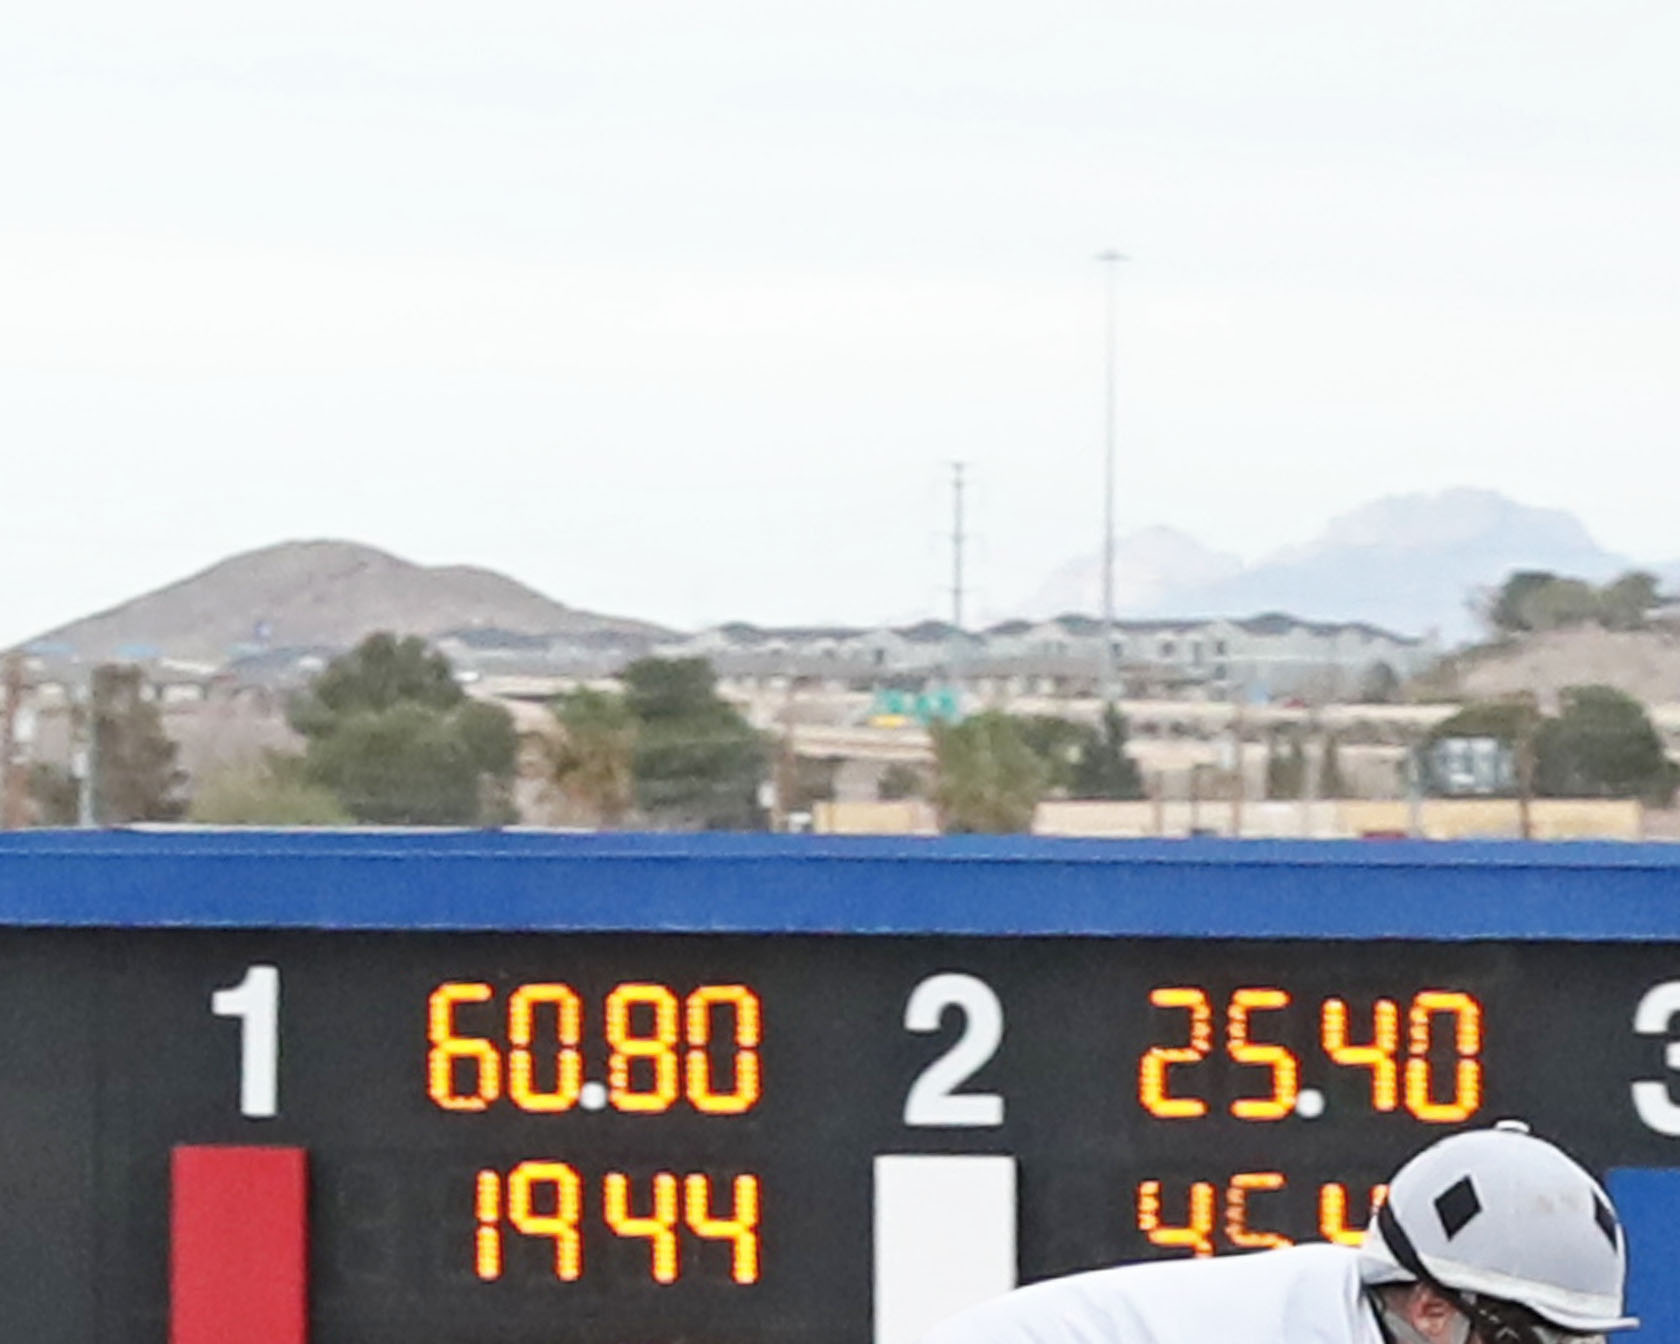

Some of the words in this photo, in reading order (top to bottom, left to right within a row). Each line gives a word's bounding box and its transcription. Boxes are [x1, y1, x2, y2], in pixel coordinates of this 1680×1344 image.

[212, 965, 279, 1117] 1
[427, 982, 762, 1115] 60.80
[903, 973, 1004, 1127] 2
[1138, 987, 1484, 1123] 25.40
